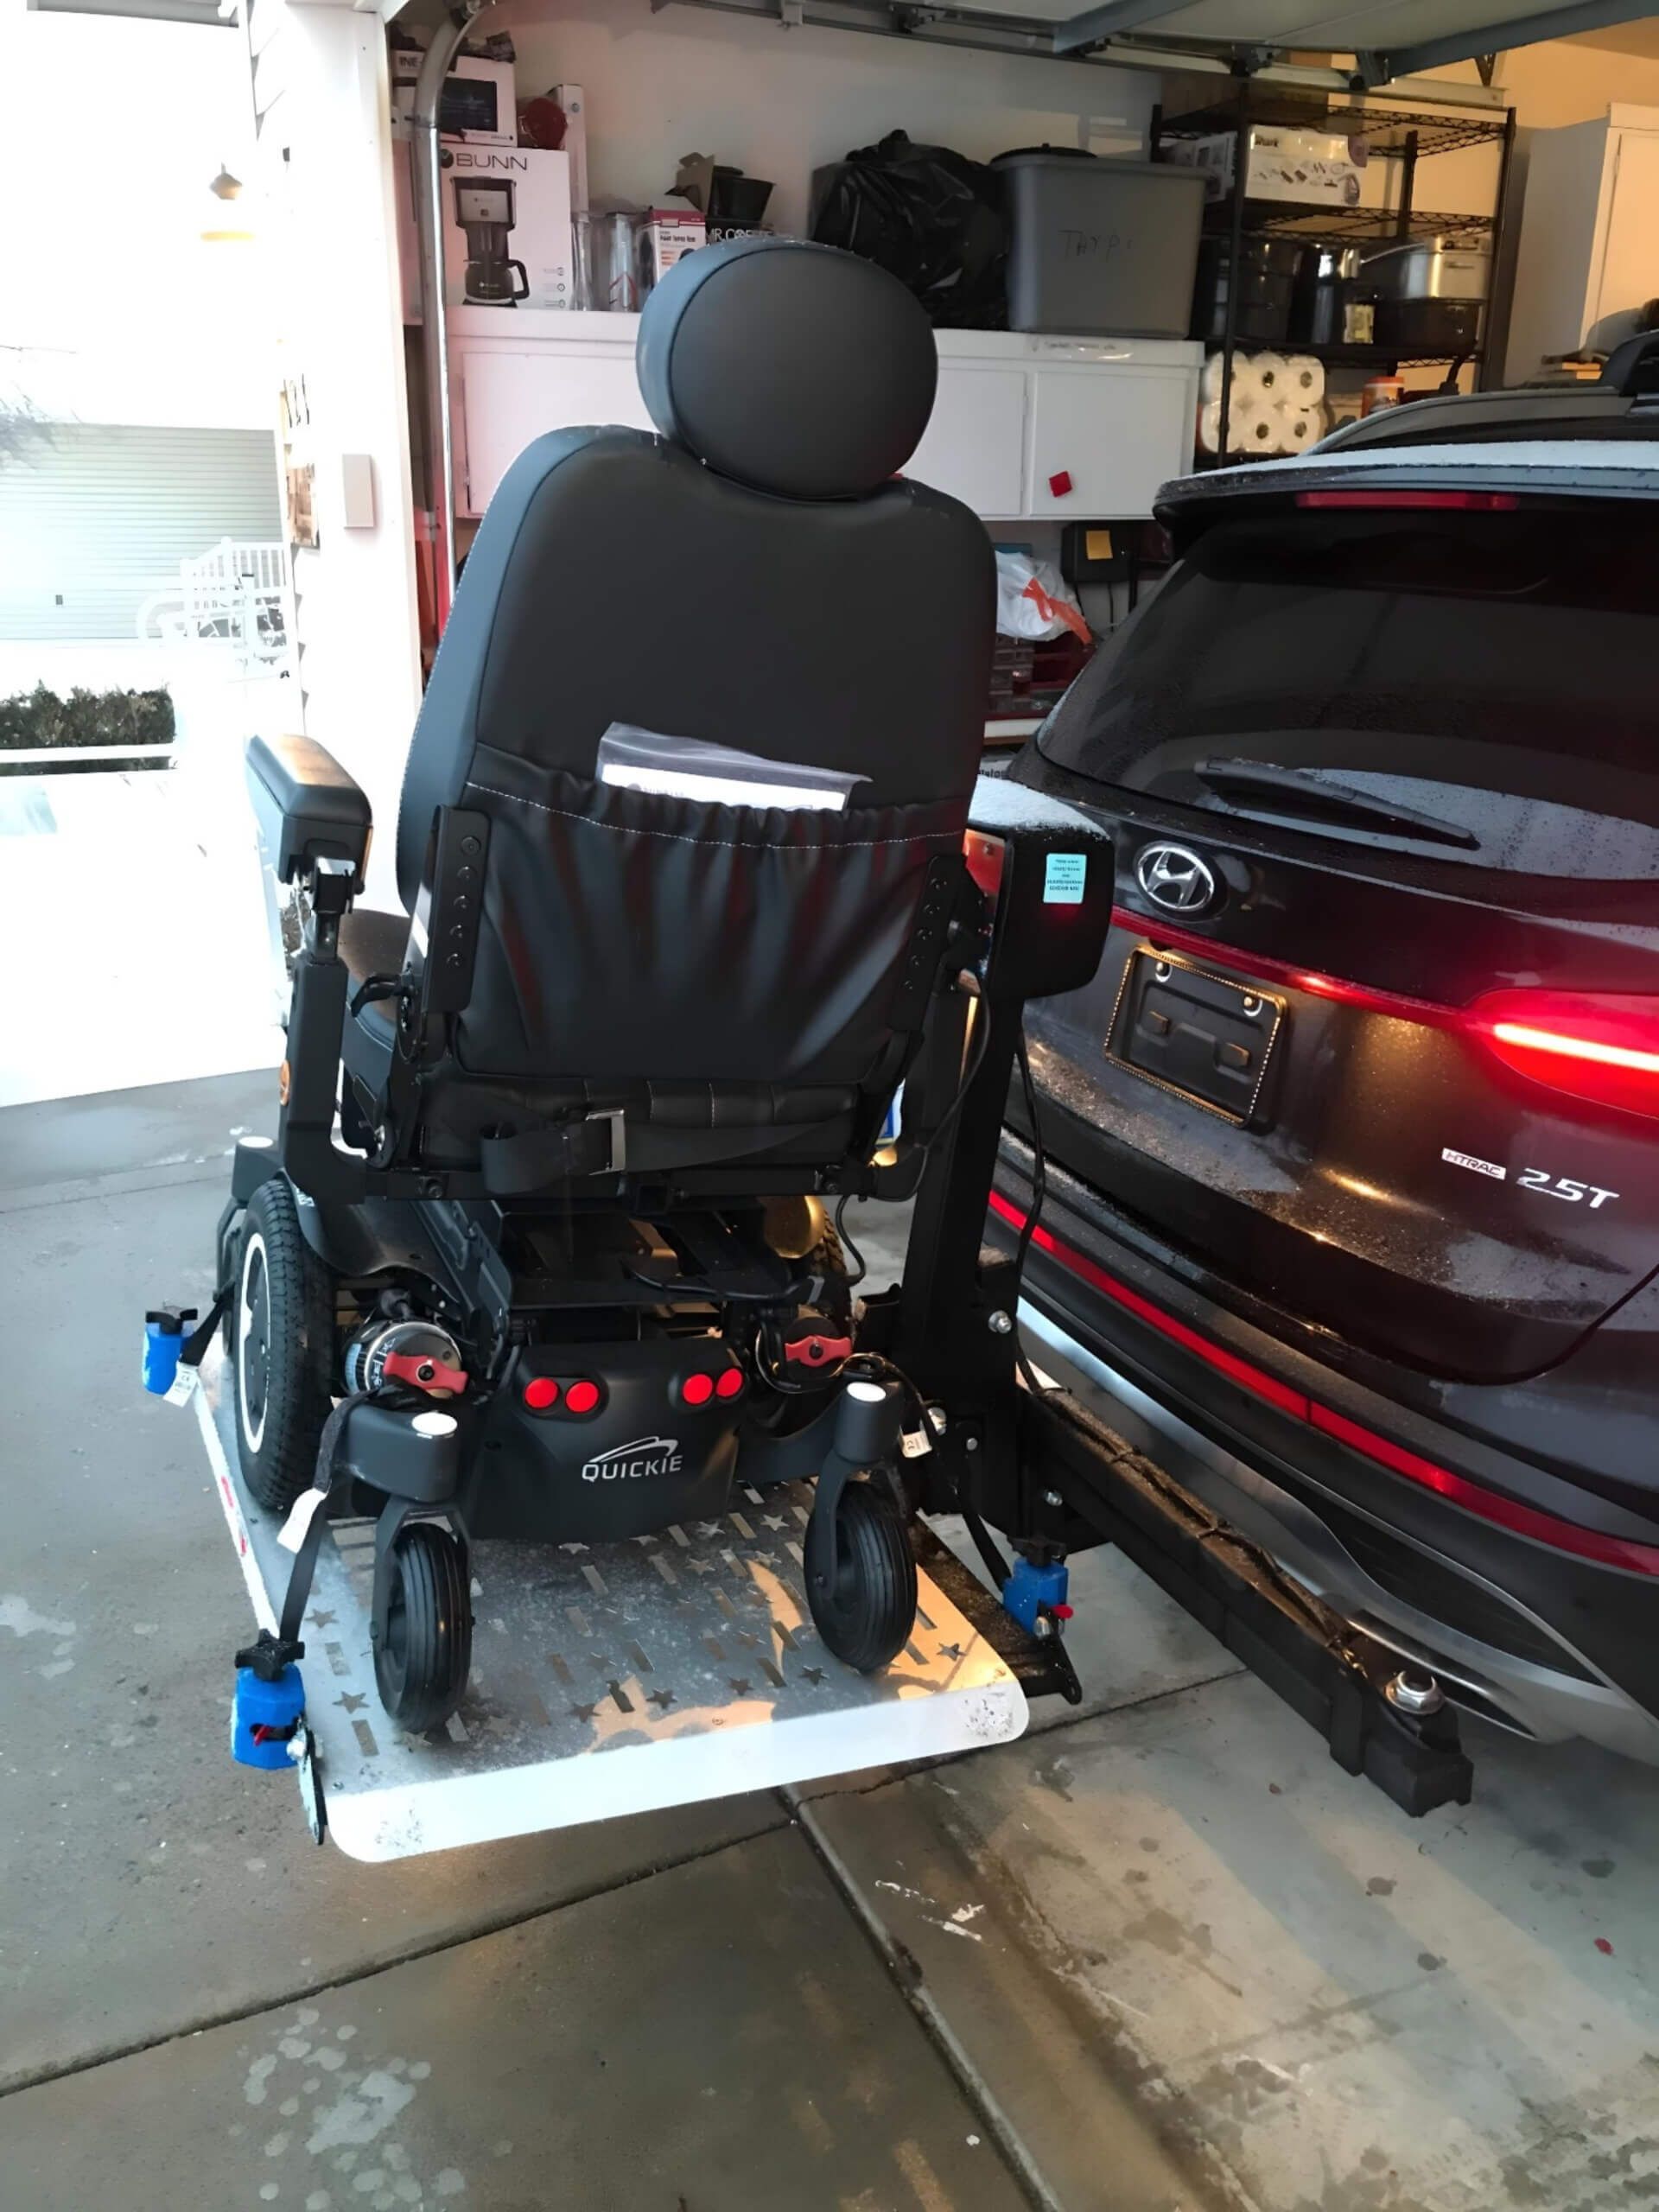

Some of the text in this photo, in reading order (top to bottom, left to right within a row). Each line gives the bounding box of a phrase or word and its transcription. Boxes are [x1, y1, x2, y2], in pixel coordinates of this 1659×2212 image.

[456, 153, 528, 171] BUNN
[1446, 1152, 1502, 1177] HTRAC
[582, 1454, 683, 1483] QUICKIE
